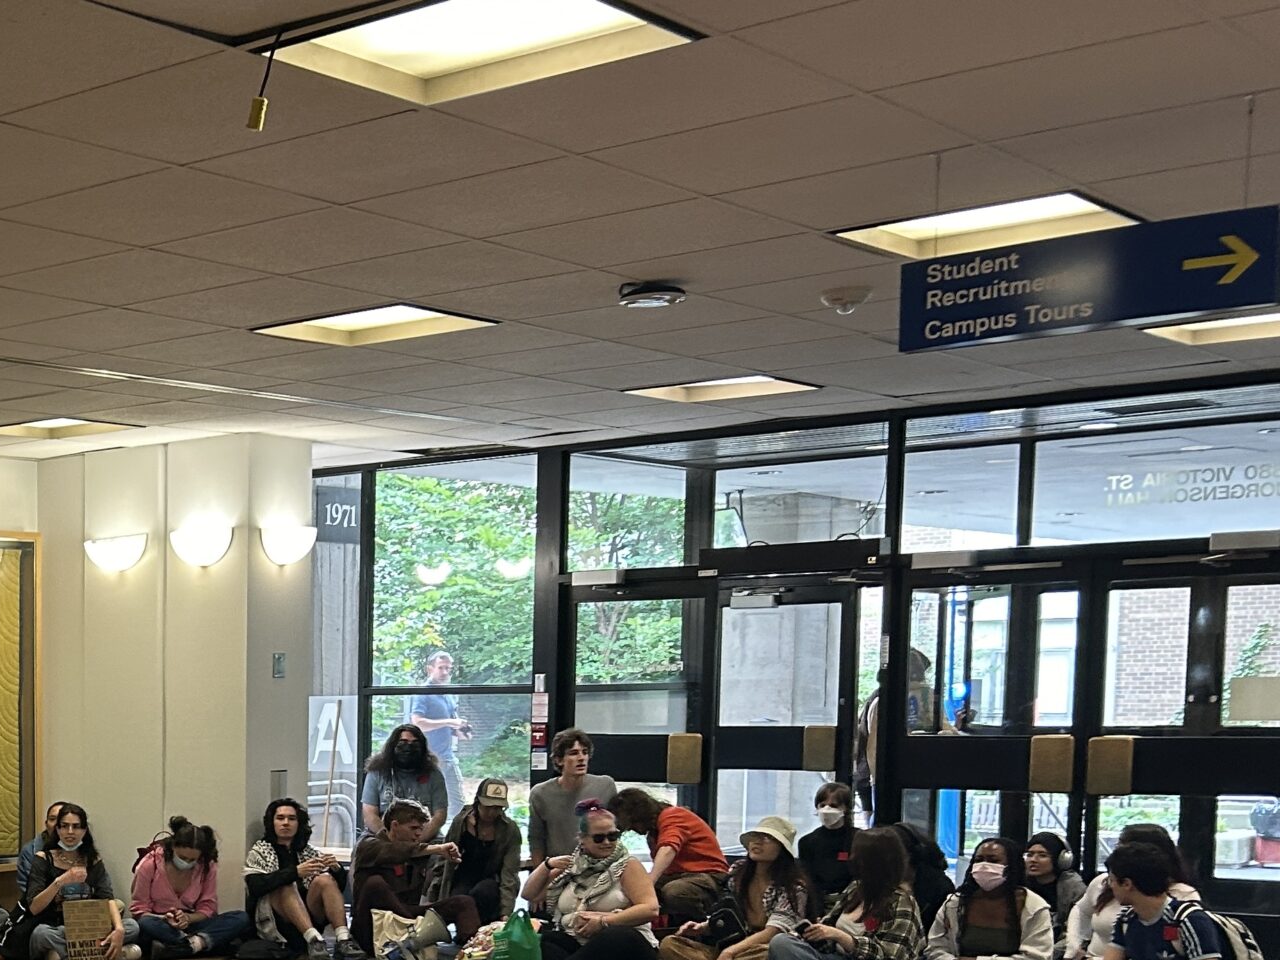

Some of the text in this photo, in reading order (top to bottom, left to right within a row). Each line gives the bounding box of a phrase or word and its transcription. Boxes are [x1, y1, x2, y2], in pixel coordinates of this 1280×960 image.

[926, 252, 1020, 284] Student
[925, 271, 1058, 310] Recruitme
[924, 301, 1094, 340] Campus Tours
[325, 502, 357, 528] 1971
[78, 940, 96, 948] WHAT
